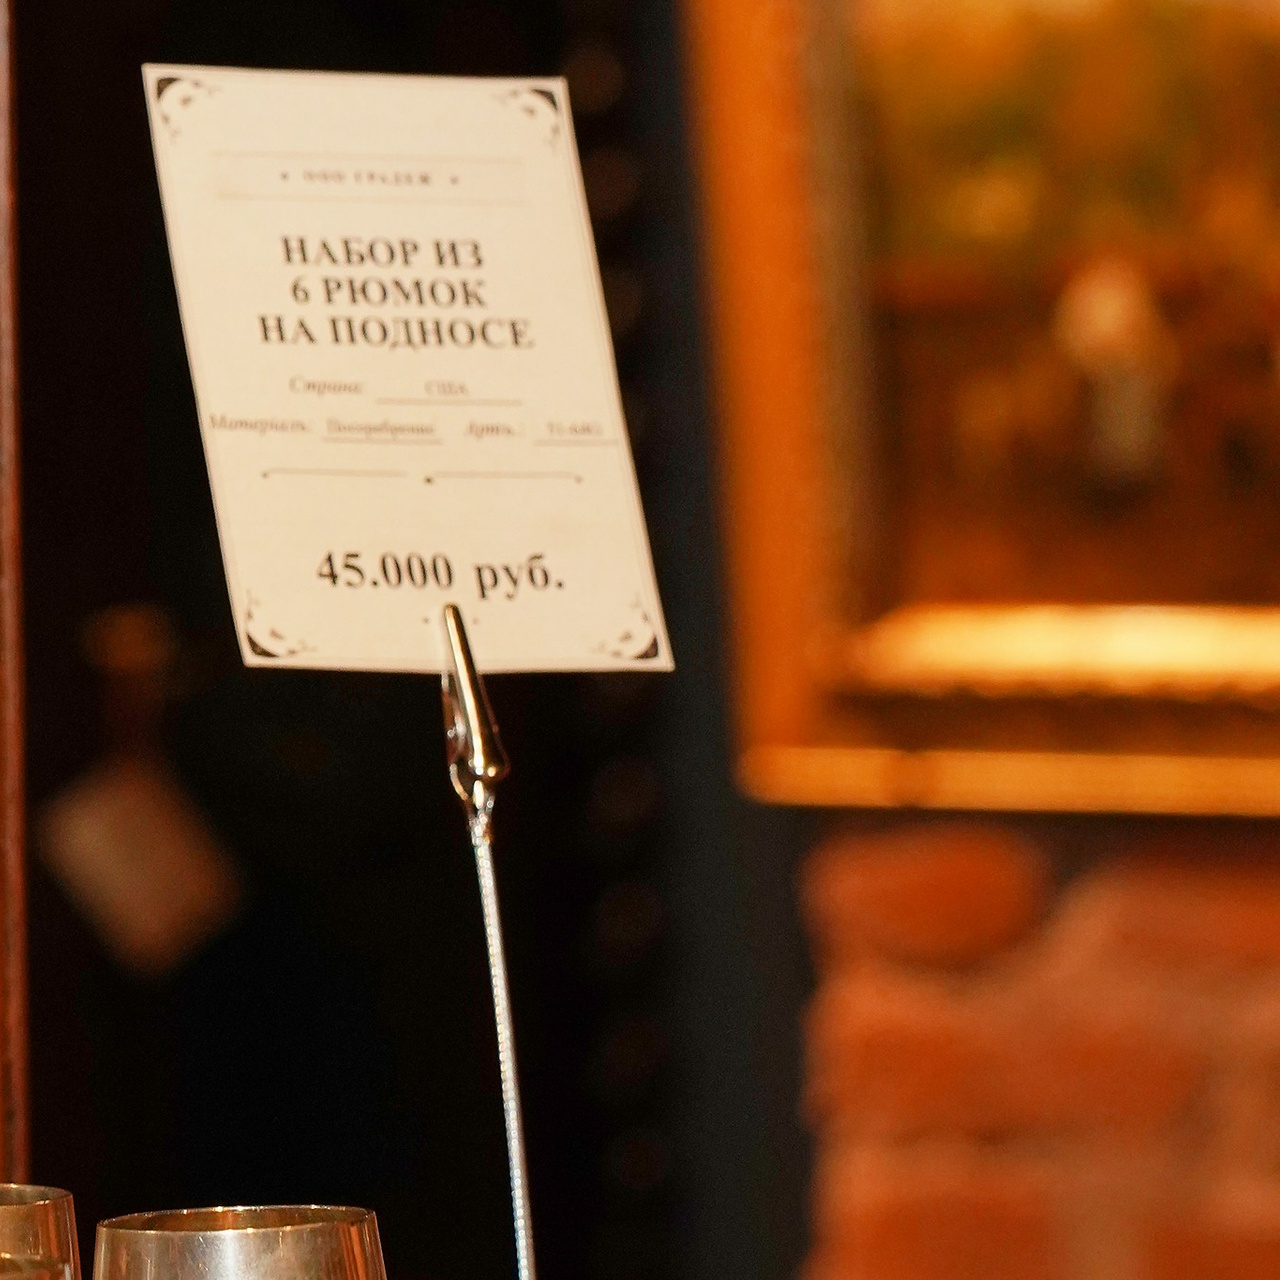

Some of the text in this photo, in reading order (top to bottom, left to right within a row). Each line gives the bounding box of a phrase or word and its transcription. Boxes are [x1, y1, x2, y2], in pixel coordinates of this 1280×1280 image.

[281, 236, 484, 269] НАБОР ИЗ
[291, 276, 488, 309] 6 РЮМОК
[259, 315, 535, 351] НА ПОДНОСЕ
[317, 551, 564, 600] 45.000 руб.
